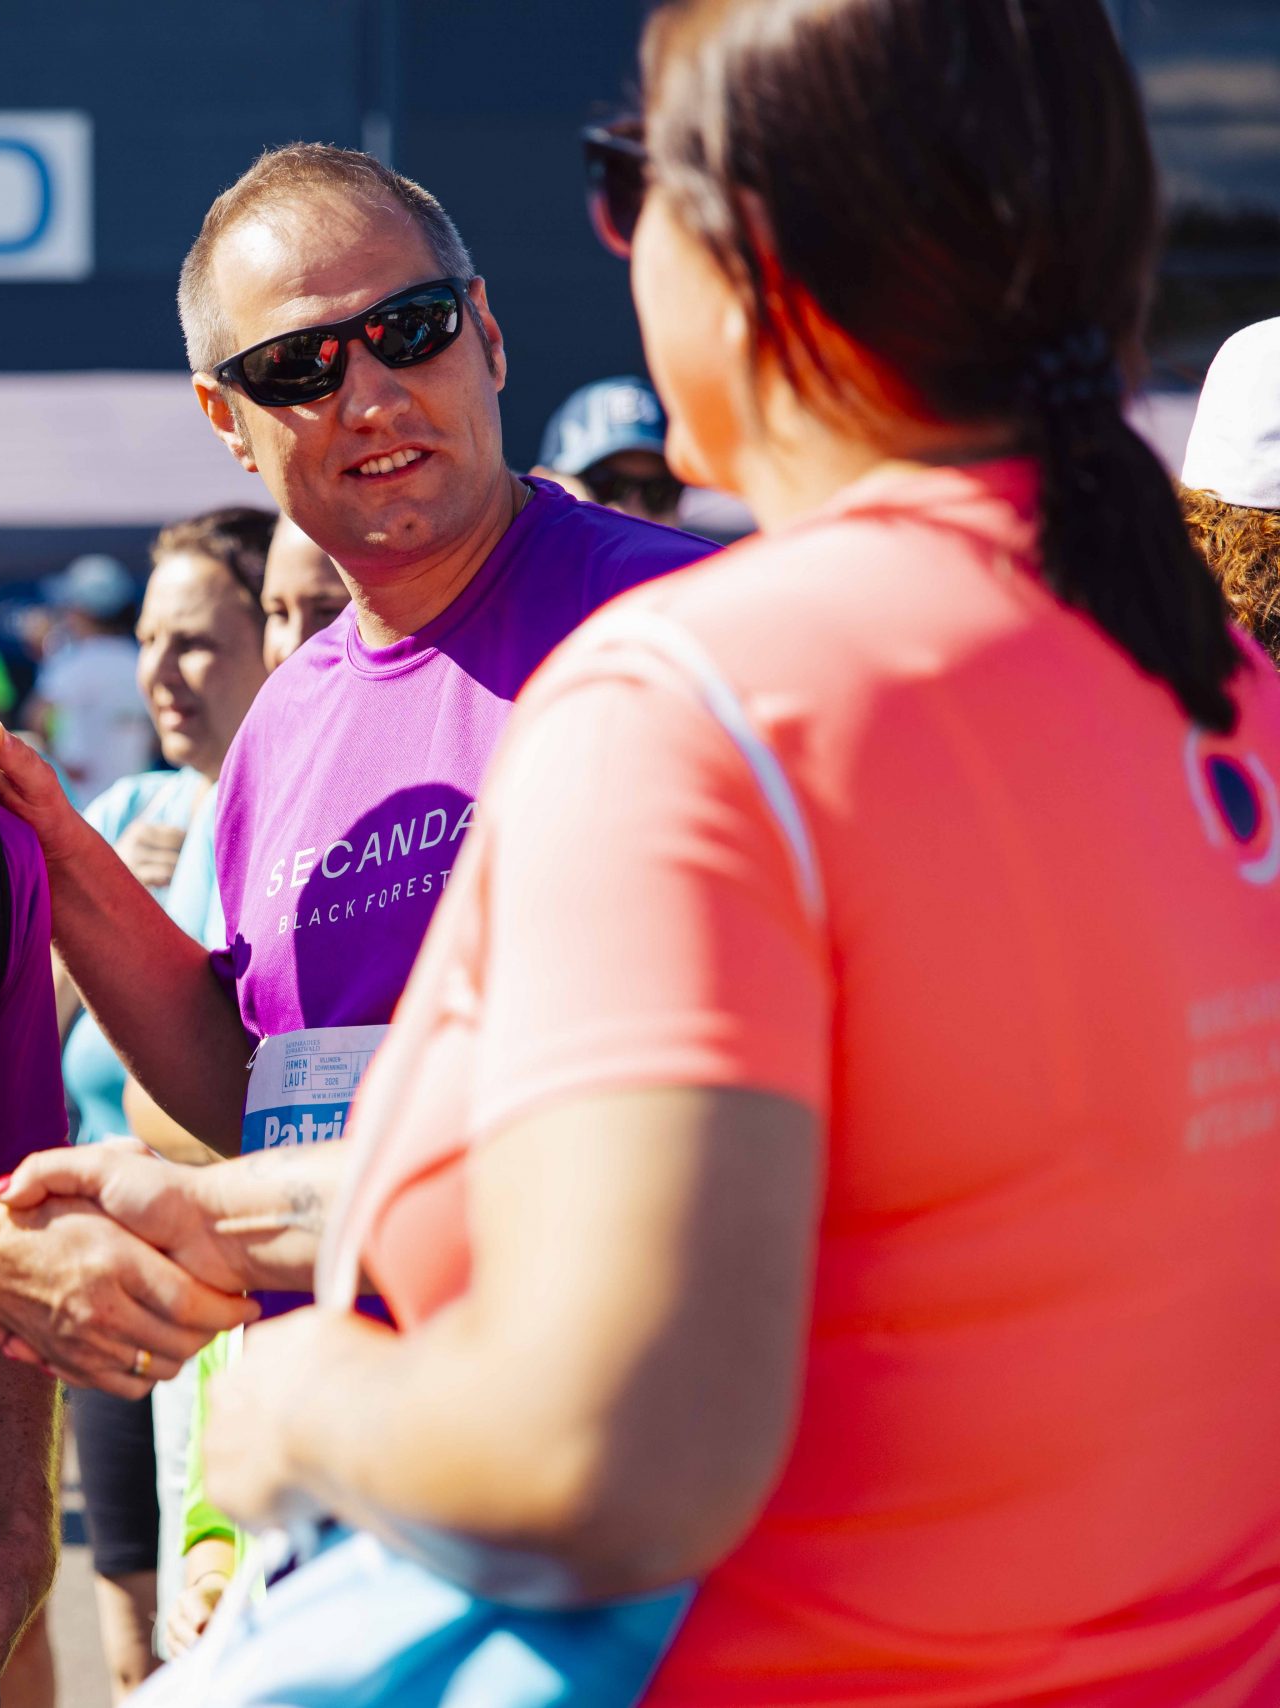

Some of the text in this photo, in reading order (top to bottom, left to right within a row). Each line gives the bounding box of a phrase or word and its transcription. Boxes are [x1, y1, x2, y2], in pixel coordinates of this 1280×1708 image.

[266, 802, 479, 898] SECANDA
[278, 869, 451, 934] BLACK FOREST
[284, 1071, 307, 1088] LAUF
[285, 1059, 308, 1071] FIRMEN
